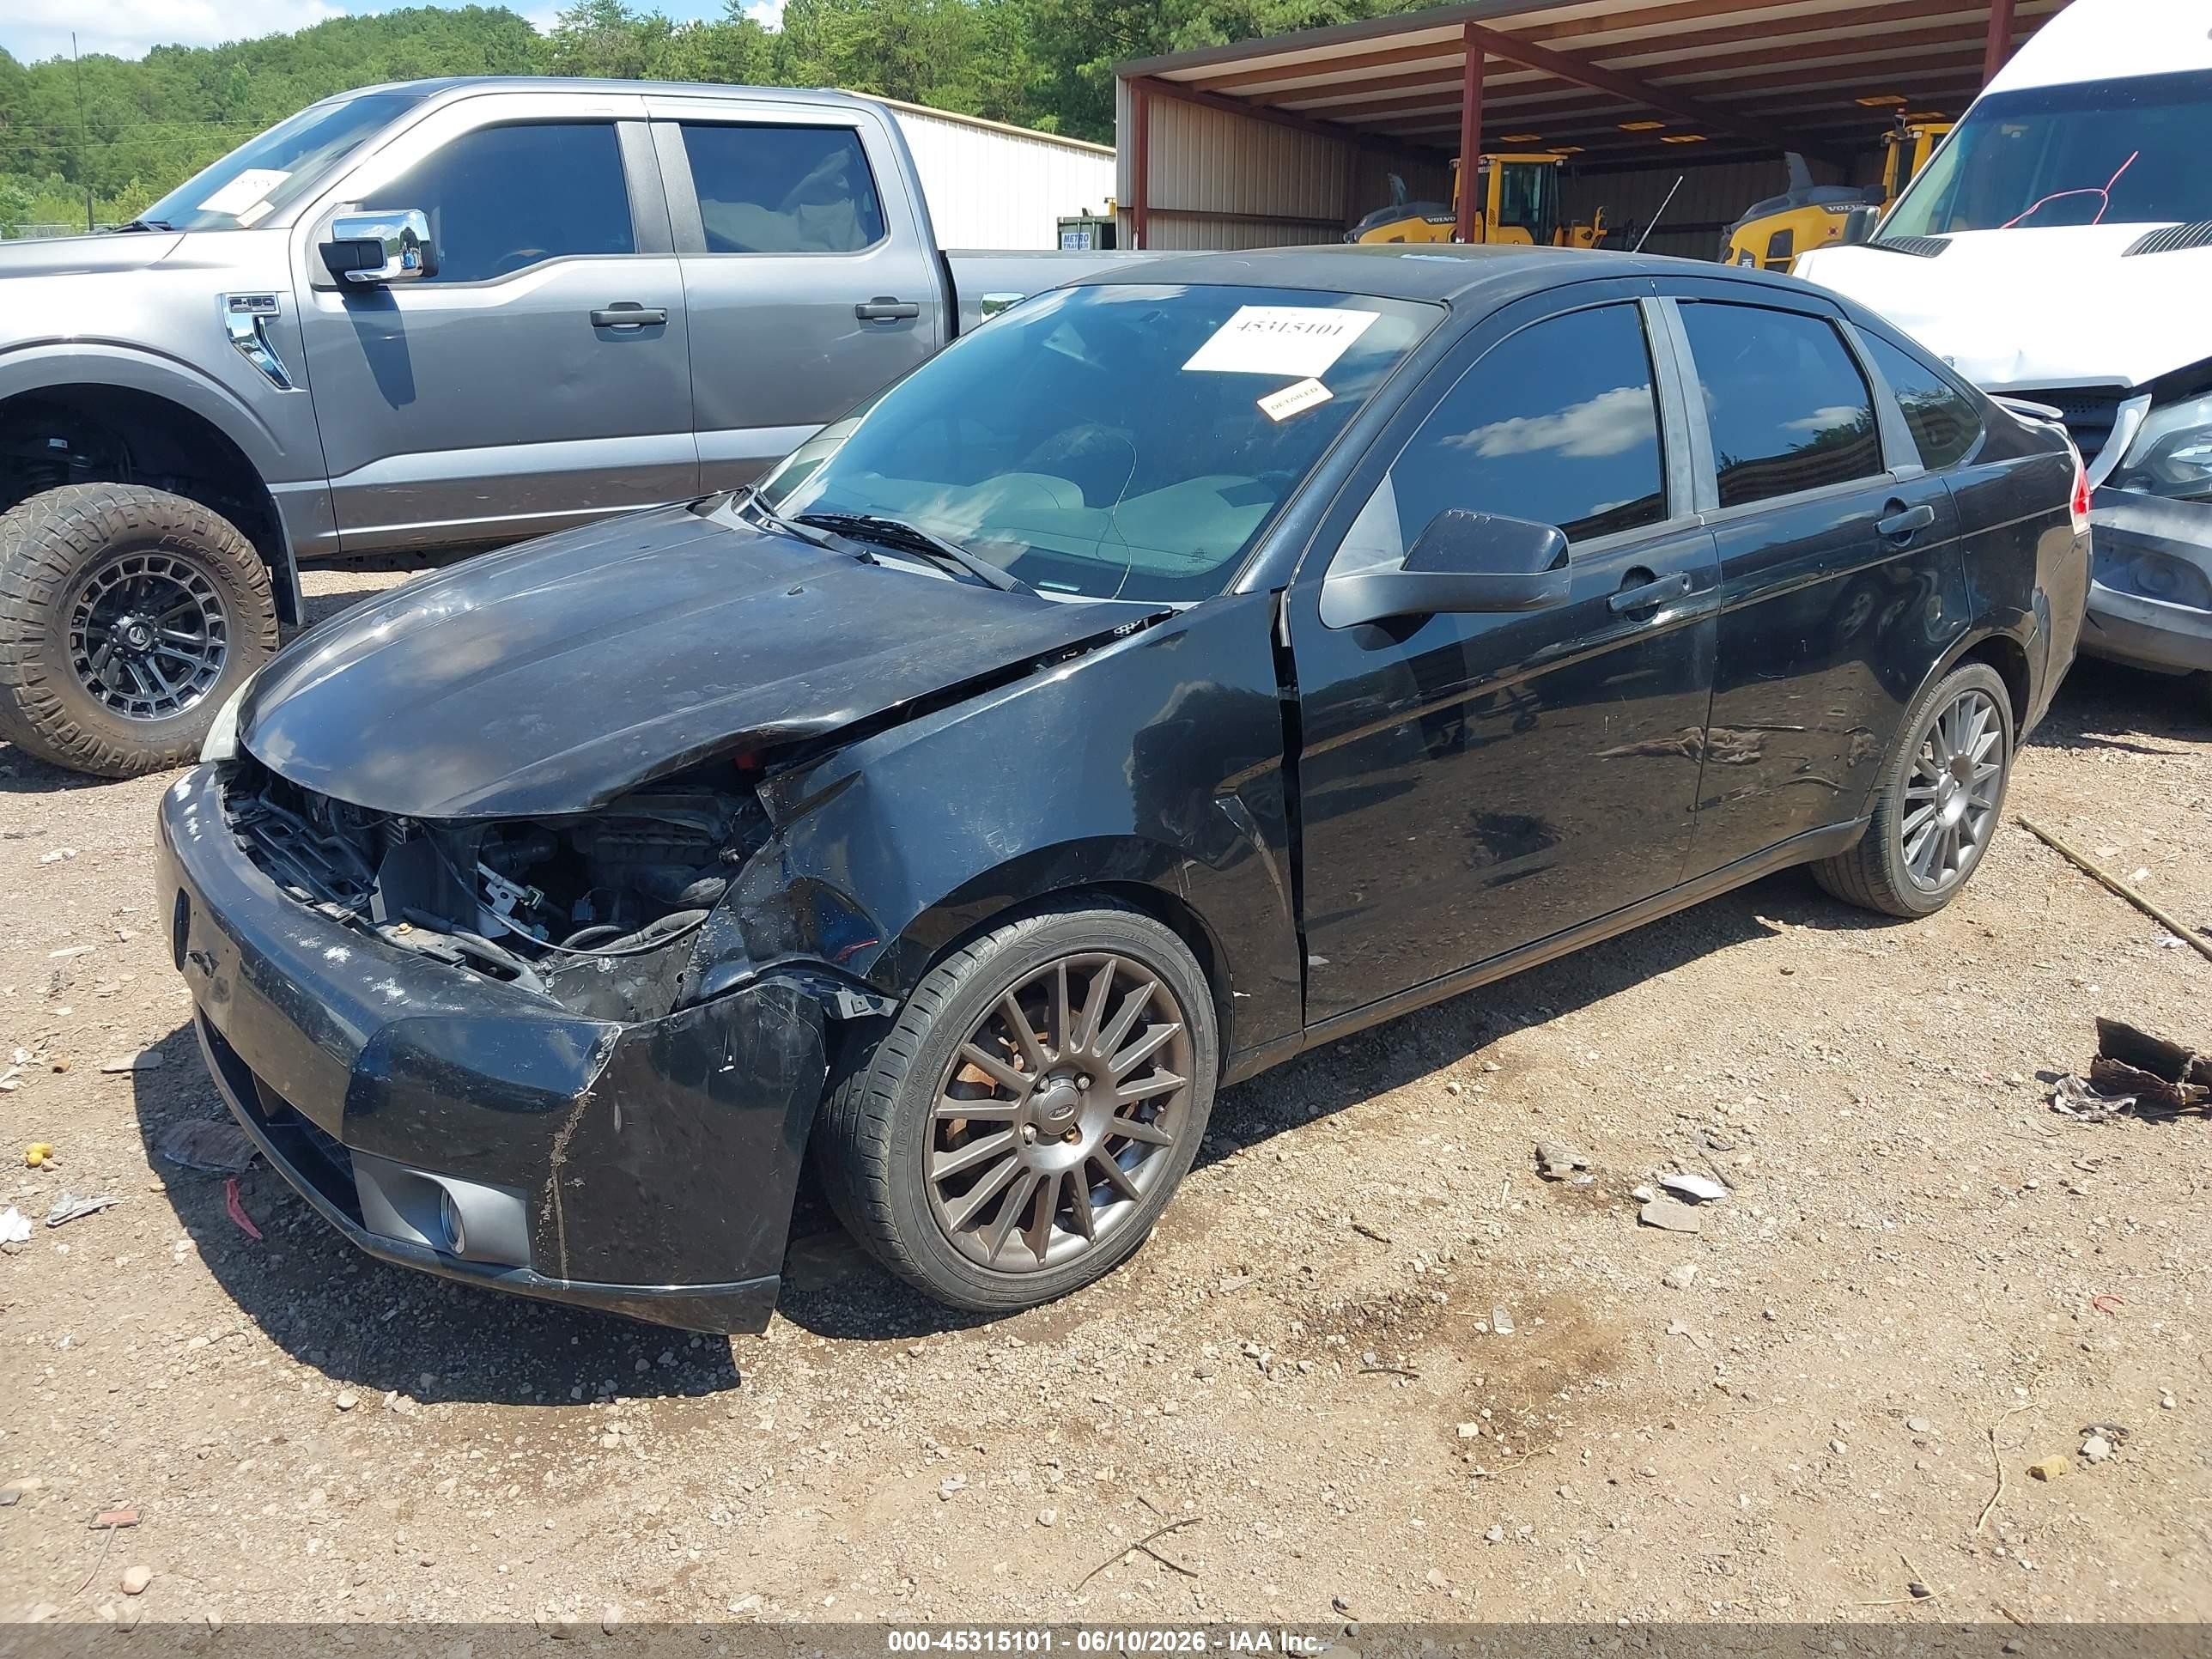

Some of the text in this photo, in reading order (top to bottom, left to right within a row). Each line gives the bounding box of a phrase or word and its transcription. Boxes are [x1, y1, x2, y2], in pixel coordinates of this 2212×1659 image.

[1064, 234, 1090, 243] METRO
[229, 295, 275, 307] F-150
[895, 1024, 946, 1156] IRONMAN
